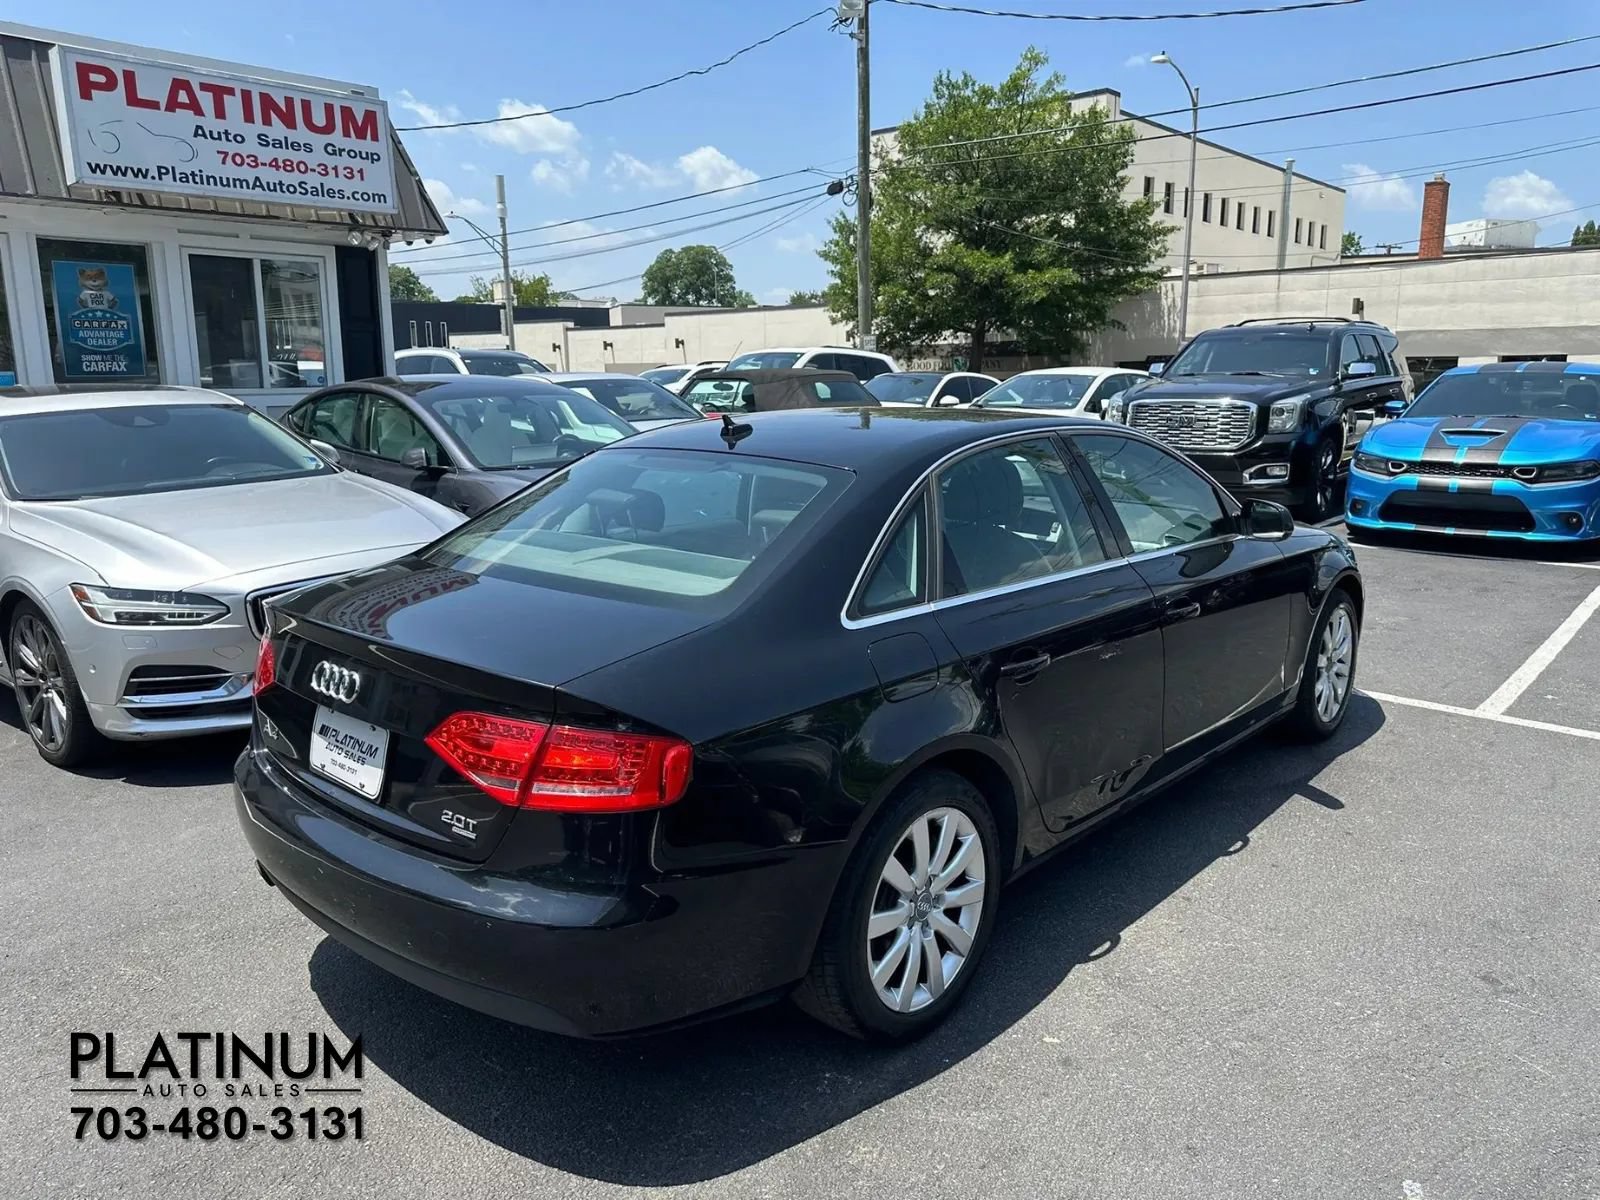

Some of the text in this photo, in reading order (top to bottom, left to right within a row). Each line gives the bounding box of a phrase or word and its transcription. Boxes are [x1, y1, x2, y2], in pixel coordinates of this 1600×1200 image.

[76, 62, 380, 142] PLATINUM
[193, 125, 382, 164] Auto Sales Group
[216, 150, 366, 182] 703-480-3131
[86, 160, 388, 204] www.PlatinumAutoSales.com
[73, 320, 128, 330] CARFAX
[79, 330, 125, 338] ADVANTAGE
[81, 354, 102, 362] SHOW
[82, 361, 128, 372] CARFAX
[1166, 416, 1209, 428] GMC
[325, 741, 367, 766] AUTO SALES
[328, 727, 379, 759] PLATINUM
